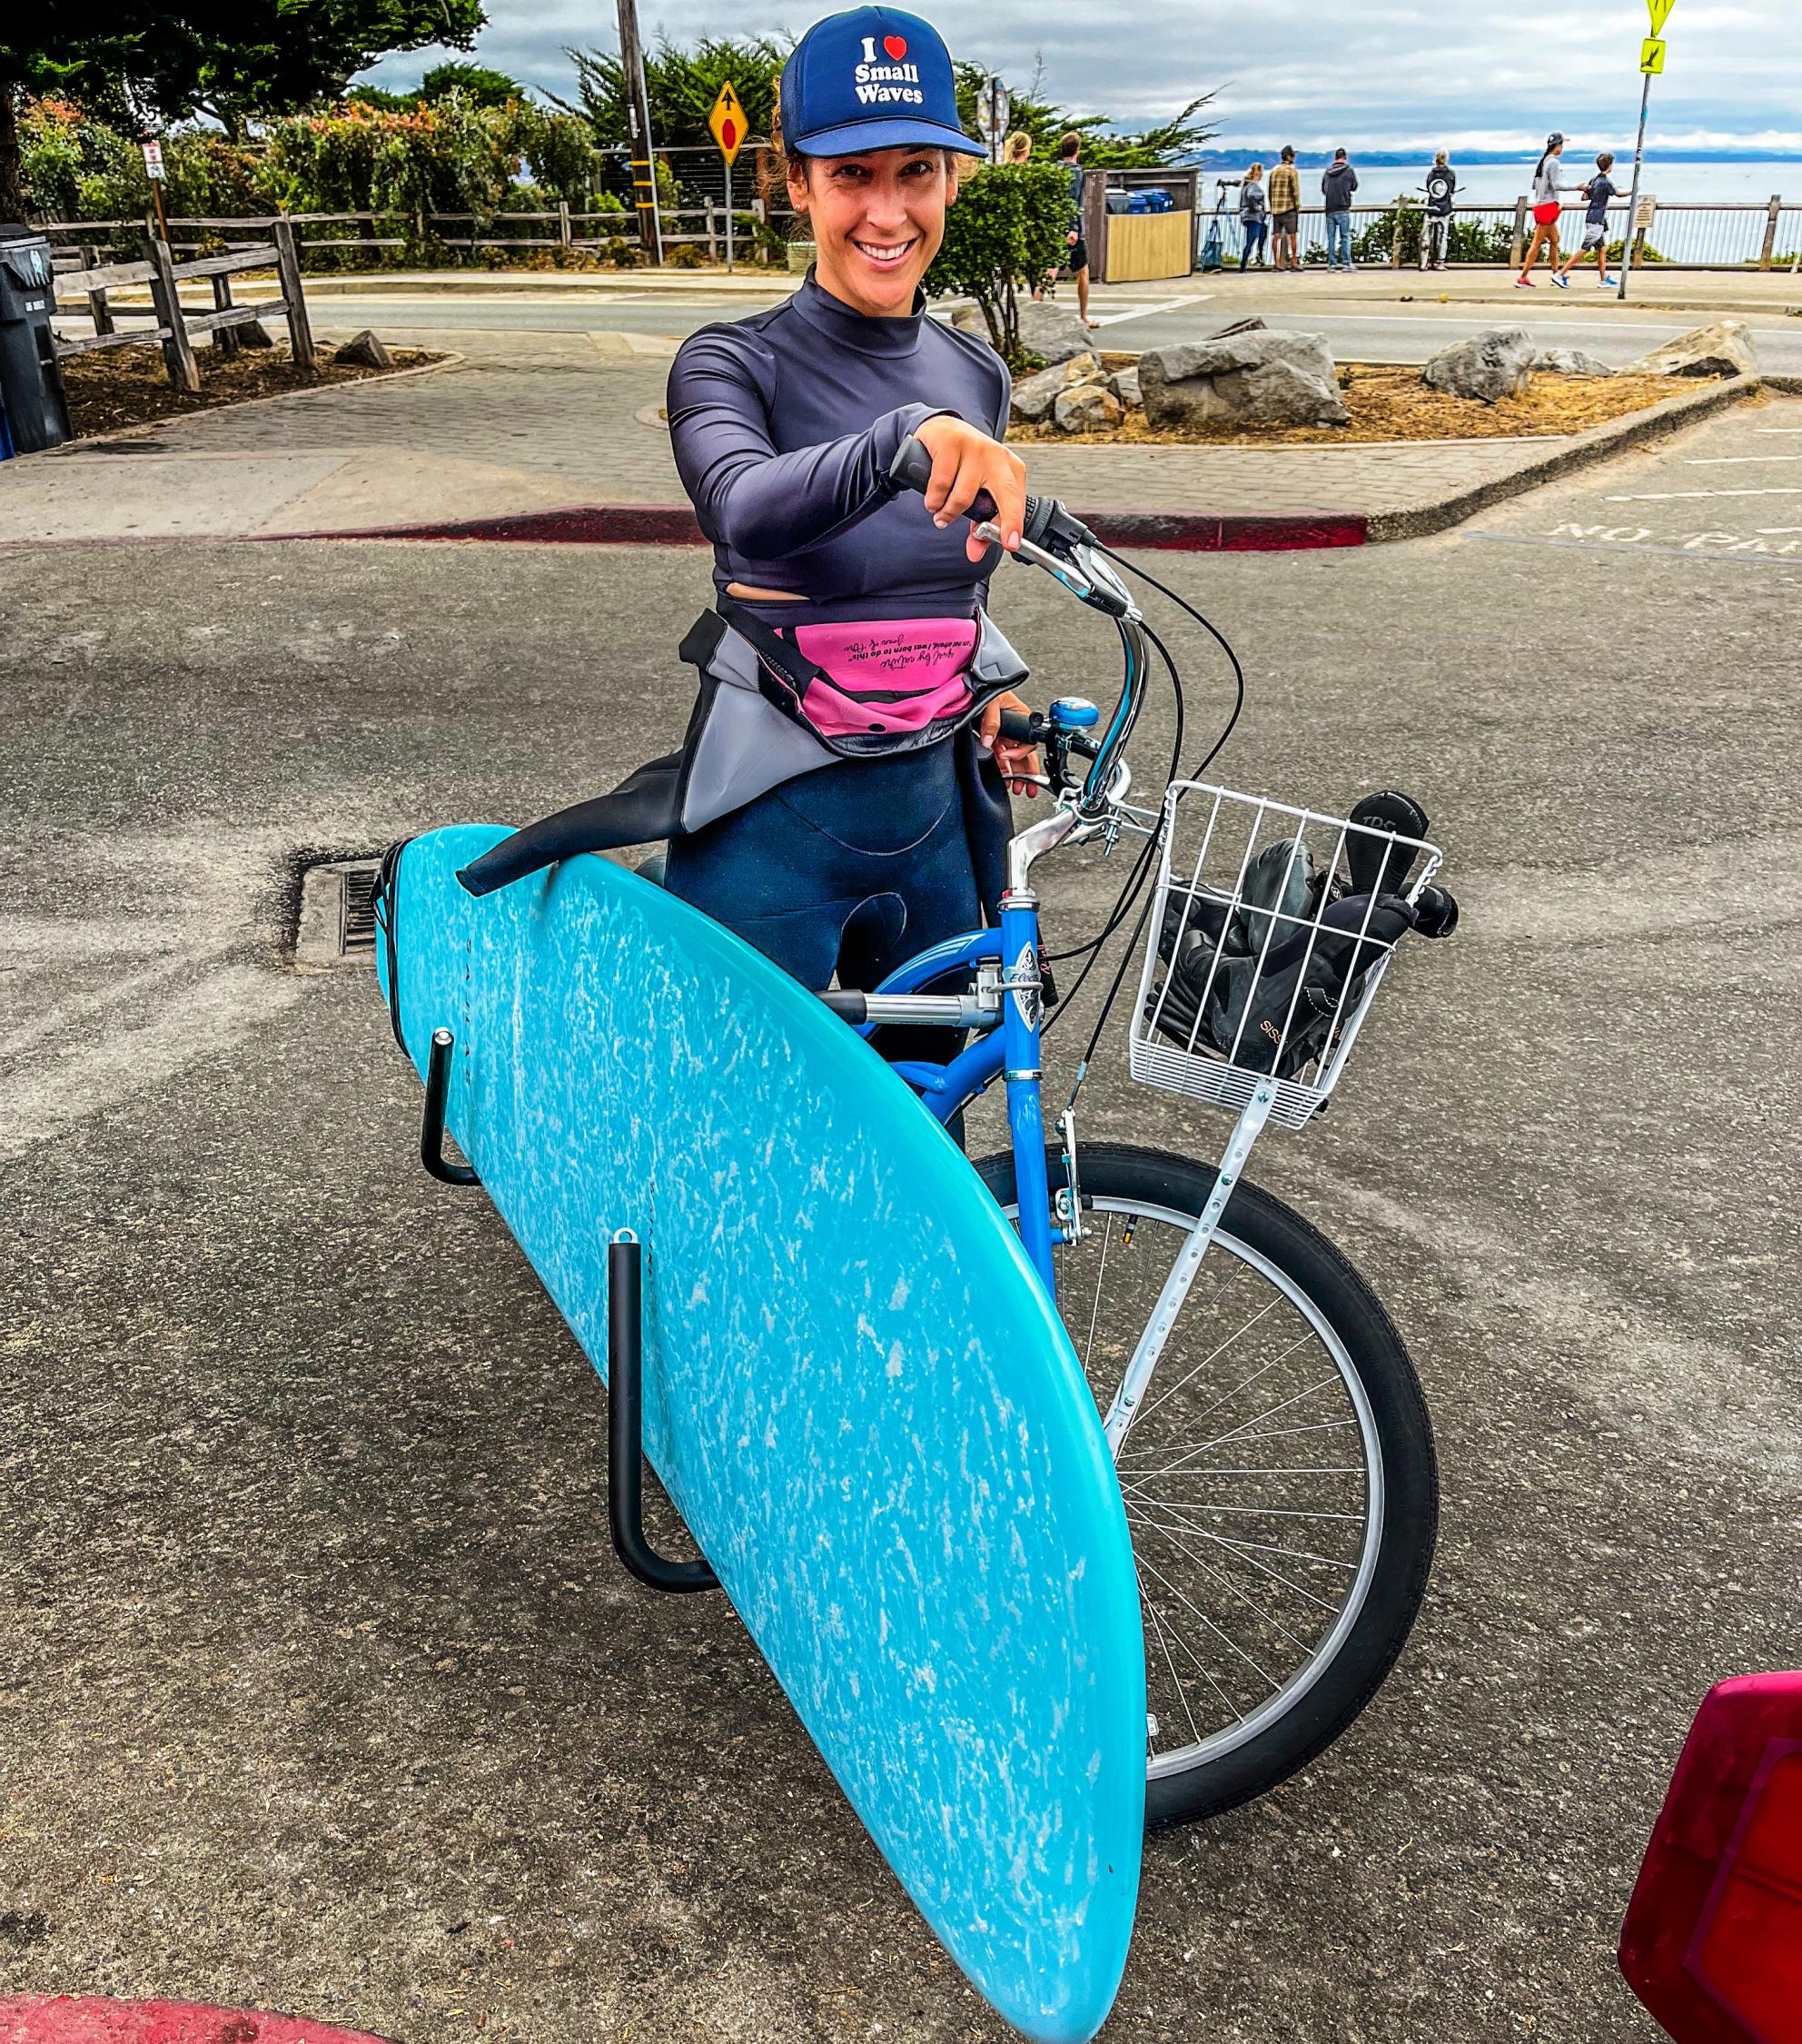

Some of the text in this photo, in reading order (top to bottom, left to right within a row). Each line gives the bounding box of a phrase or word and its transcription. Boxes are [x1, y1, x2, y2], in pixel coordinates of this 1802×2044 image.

[861, 36, 877, 63] I
[855, 63, 919, 84] Small
[855, 84, 924, 104] Waves
[1544, 522, 1651, 542] NO
[870, 650, 882, 658] do
[894, 644, 913, 653] born
[880, 654, 916, 670] nature
[917, 650, 931, 667] by
